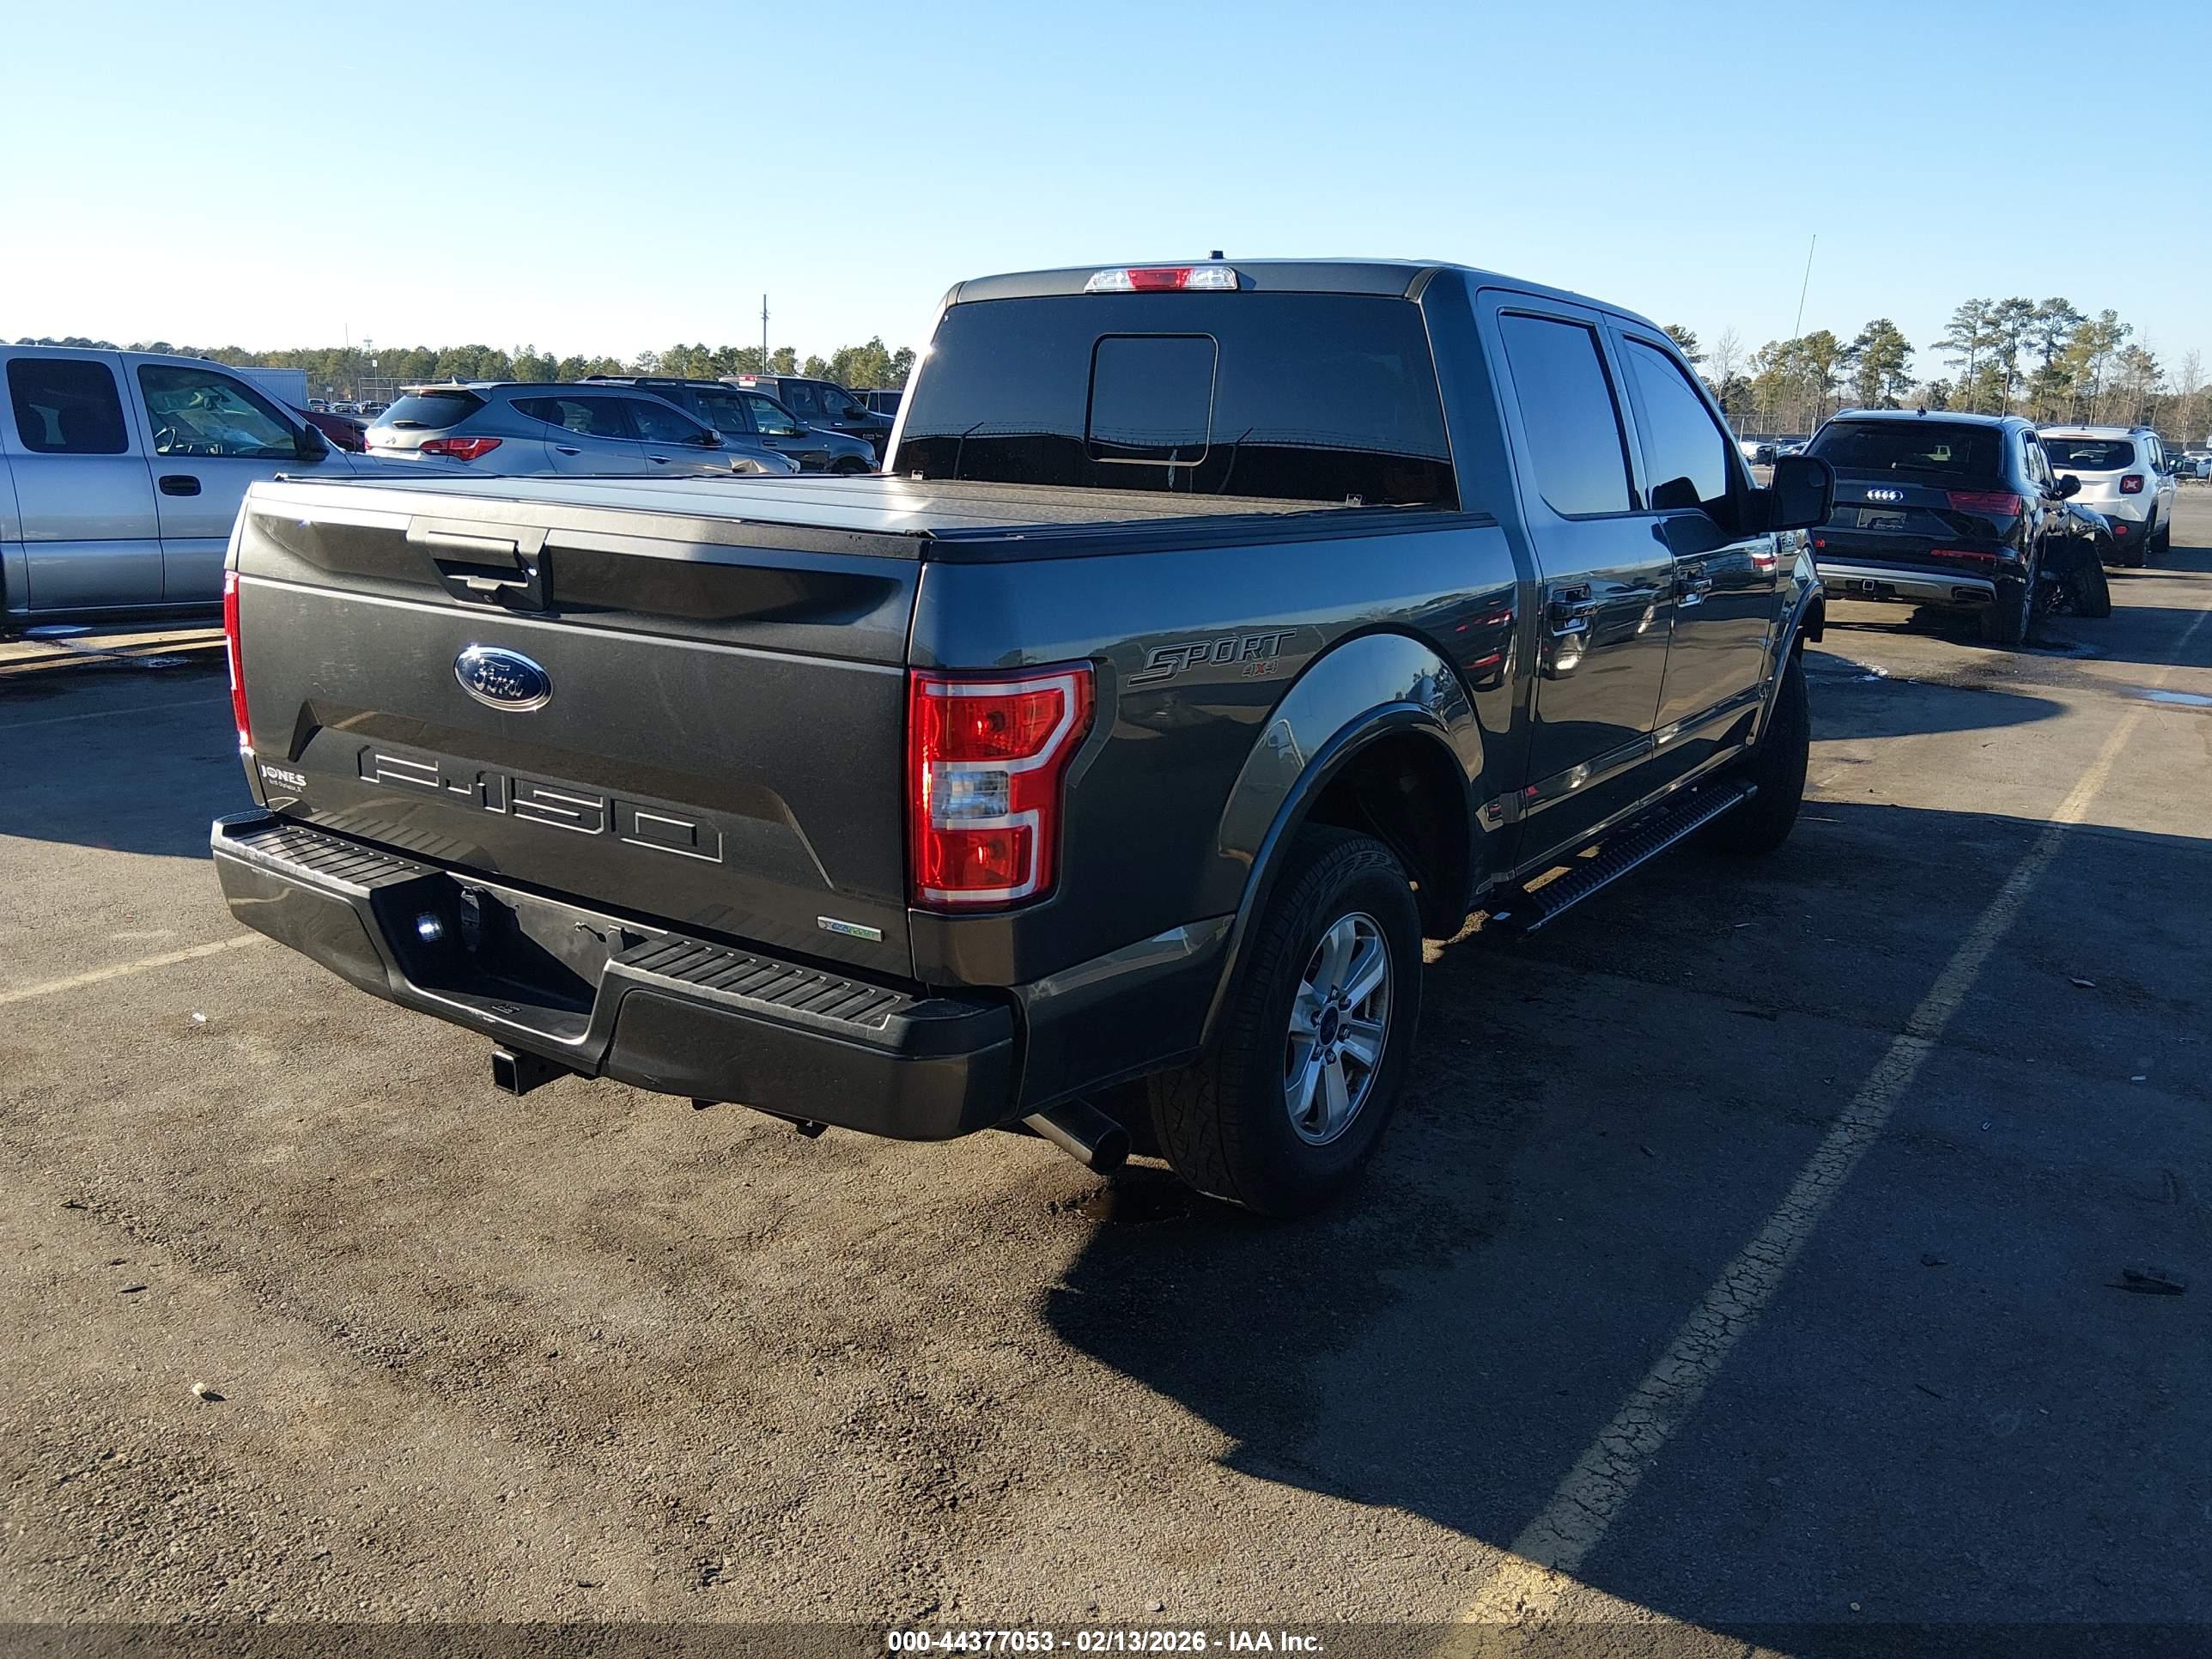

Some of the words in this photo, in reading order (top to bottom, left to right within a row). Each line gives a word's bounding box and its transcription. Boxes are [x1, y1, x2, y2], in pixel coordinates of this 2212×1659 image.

[472, 658, 525, 698] Ford
[1127, 628, 1297, 687] SPORT
[260, 765, 307, 787] JONES
[357, 744, 723, 863] F-150
